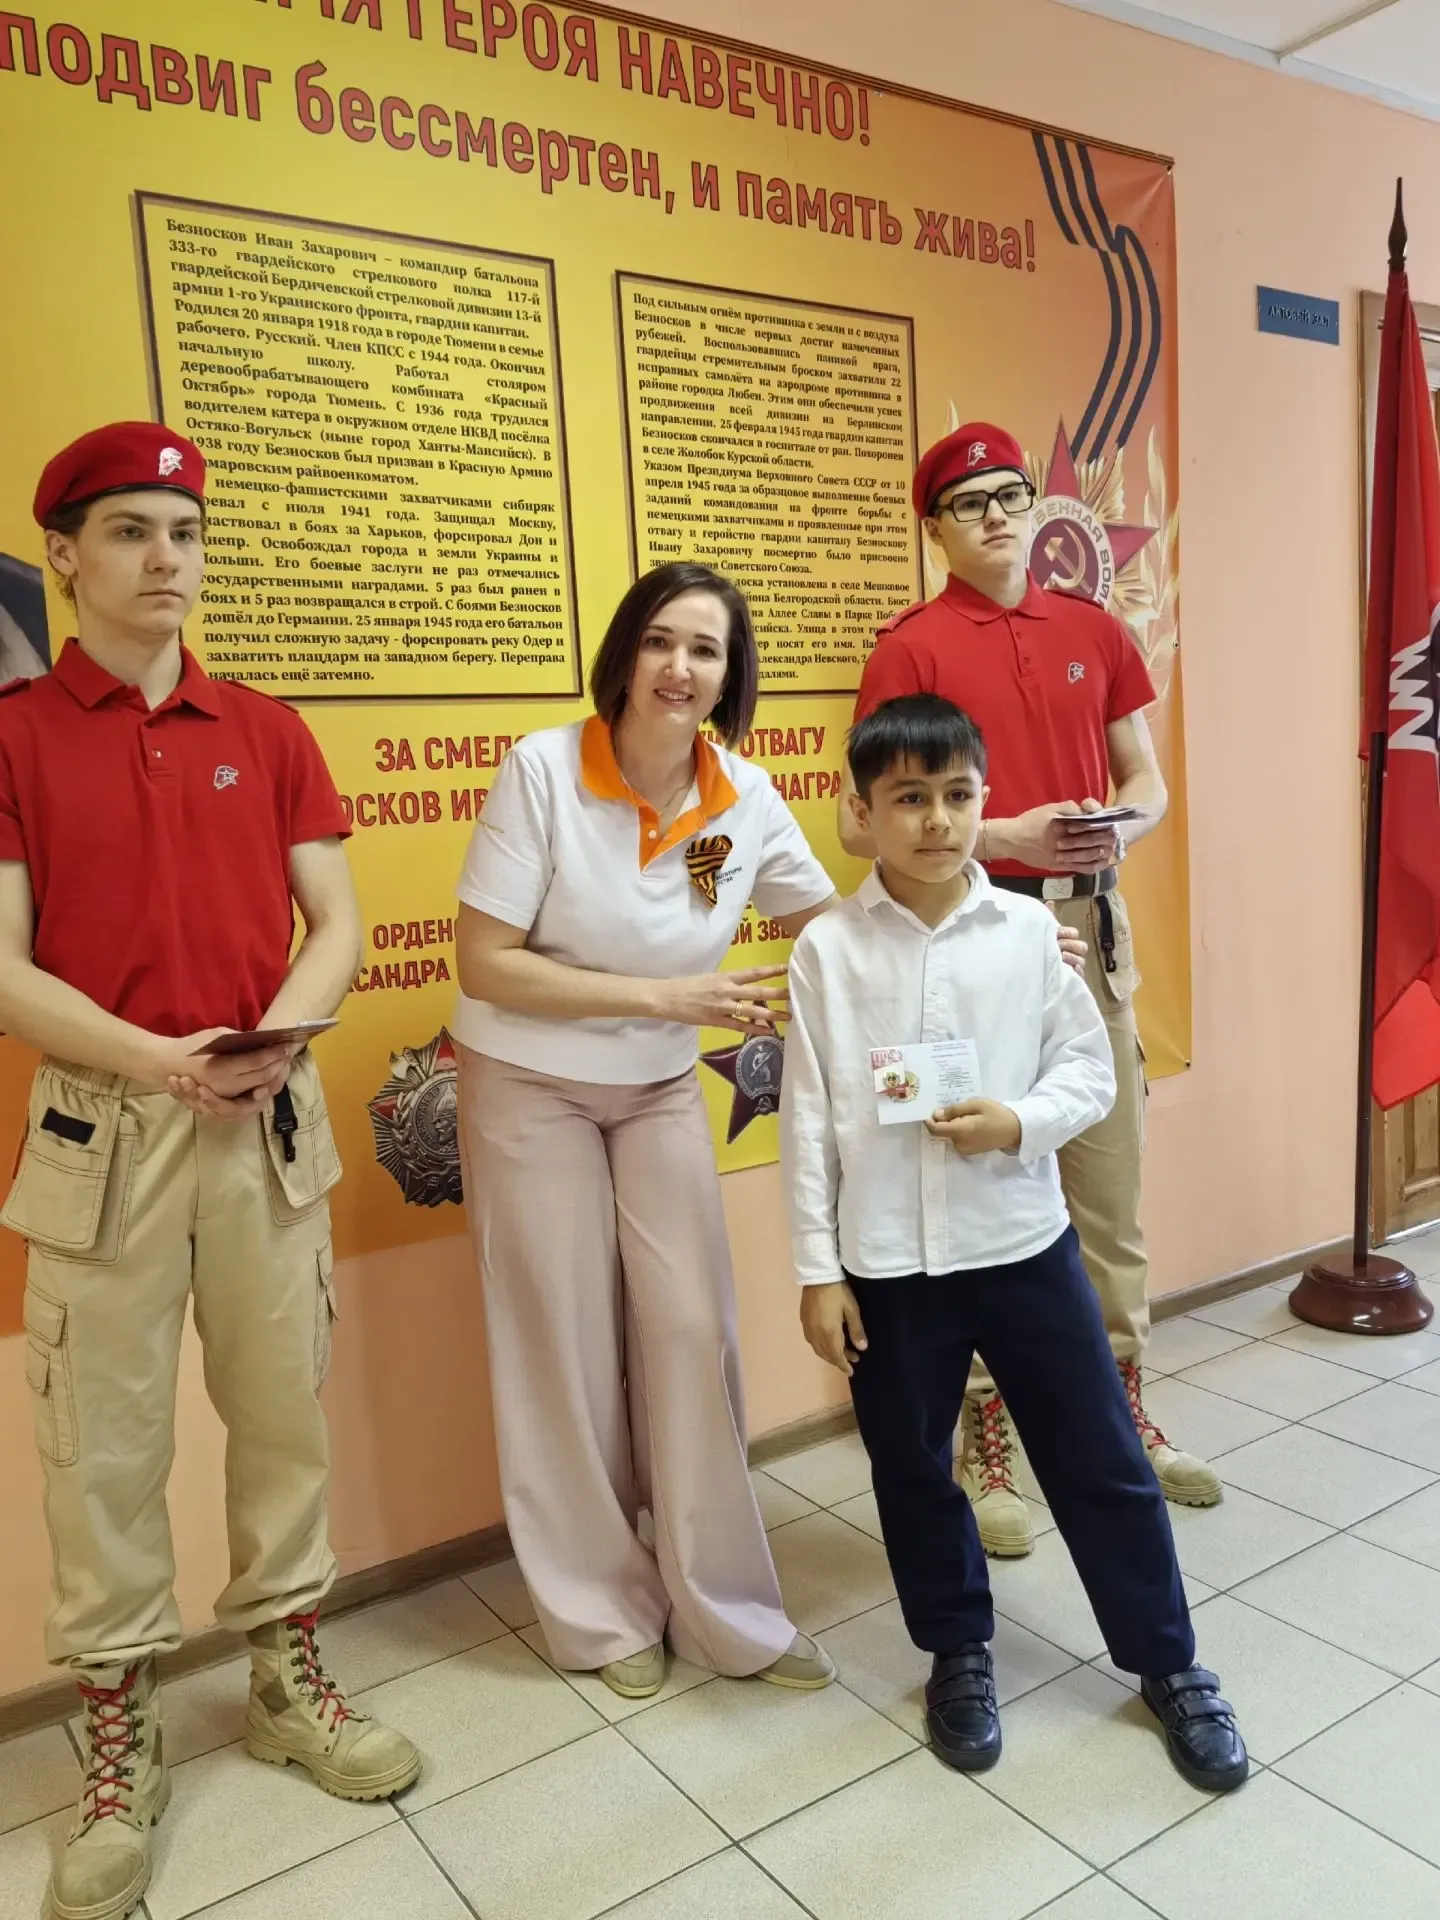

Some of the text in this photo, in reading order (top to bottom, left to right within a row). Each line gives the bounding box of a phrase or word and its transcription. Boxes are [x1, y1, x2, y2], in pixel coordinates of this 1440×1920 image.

[617, 26, 870, 146] НАВЕЧНО!
[295, 60, 675, 214] бессмертен,
[691, 161, 720, 211] и
[736, 170, 903, 246] память
[914, 207, 1036, 272] жива!
[165, 218, 538, 288] Безносков Иван Захарович командир батальона
[168, 238, 540, 306] 333-го гвардейского стрелкового полка 117-й
[170, 260, 541, 323] гвардейской Бердичевской стрелковой дивизии 13-й
[172, 281, 529, 339] армии 1-го Украинского фронта, гвардии капитан.
[175, 319, 545, 375] рабочего. Русский. Член КПСС с 1944 года. Окончил
[178, 340, 546, 394] начальную школу. Работал столяром
[815, 353, 857, 366] паникой
[872, 361, 900, 374] врага,
[179, 360, 547, 410] деревообрабатывающего комбината «Красный
[638, 376, 678, 391] районе
[681, 383, 724, 397] городка
[727, 387, 764, 401] Любен.
[767, 392, 794, 404] Этим
[796, 397, 816, 407] они
[876, 407, 902, 417] успех
[791, 363, 832, 378] броском
[890, 377, 901, 387] 22
[181, 377, 548, 427] Октябрь» города Тюмень. С 1936 года трудился
[183, 399, 550, 444] водителем катера в окружном отделе НКВД посёлка
[185, 416, 551, 461] Остяко-Вогульск (ныне город Ханты-Мансийск). В
[189, 435, 552, 479] 1938 году Безносков был призван в Красную Армию
[641, 426, 698, 442] Безносков
[699, 434, 754, 447] скончался
[756, 439, 763, 448] в
[817, 445, 830, 454] от
[831, 446, 852, 458] ран.
[854, 446, 904, 462] Похоронен
[642, 444, 649, 453] в
[650, 446, 675, 456] селе
[676, 445, 725, 460] Жолобок
[726, 450, 769, 464] Курской
[214, 478, 554, 515] немецко-фашистскими захватчиками сибиряк
[644, 477, 683, 490] апреля
[687, 479, 710, 491] 1945
[712, 483, 736, 494] года
[738, 484, 750, 493] за
[752, 483, 809, 498] образцовое
[872, 492, 905, 504] боевых
[1031, 501, 1103, 543] ВЕННАЯ
[200, 574, 560, 598] государственными наградами. 5 раз был ранен в
[720, 559, 778, 572] Советского
[778, 562, 812, 573] Союза.
[201, 609, 562, 630] дошёл до Германии. 25 января 1945 года его батальон
[205, 649, 565, 666] захватить плацдарм на западном берегу. Переправа
[375, 738, 416, 772] ЗА
[424, 735, 526, 770] СМЕЛ
[739, 727, 826, 757] ОТВАГУ
[348, 958, 451, 992] САНДРА
